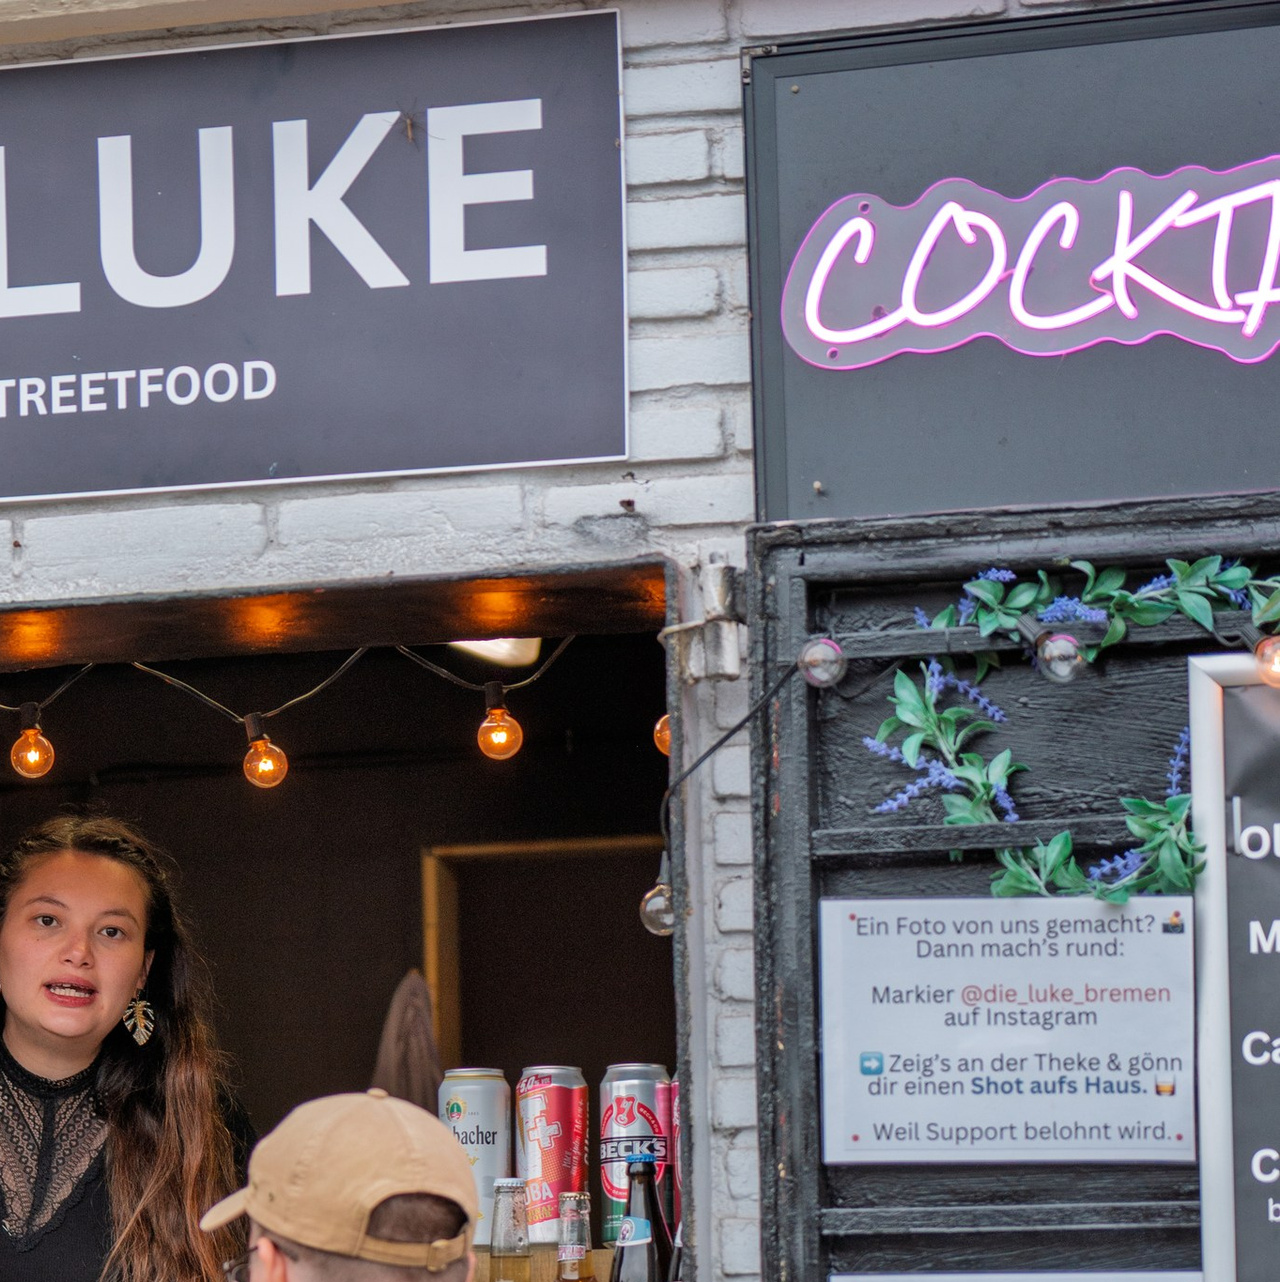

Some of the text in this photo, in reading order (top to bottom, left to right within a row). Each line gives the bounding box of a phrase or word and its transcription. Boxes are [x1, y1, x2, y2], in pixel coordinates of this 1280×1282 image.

[857, 909, 1155, 939] Ein Foto von uns gemacht?
[917, 938, 1123, 958] Dann mach’s rund:
[872, 984, 1170, 1006] Markier @die_luke_bremen
[945, 1007, 1097, 1030] auf Instagram
[889, 1053, 1182, 1077] Zeig’s an der Theke gönn
[869, 1076, 1147, 1095] dir einen Shot aufs Haus.
[453, 1125, 497, 1145] bacher
[873, 1121, 1171, 1145] Weil Support belohnt wird.
